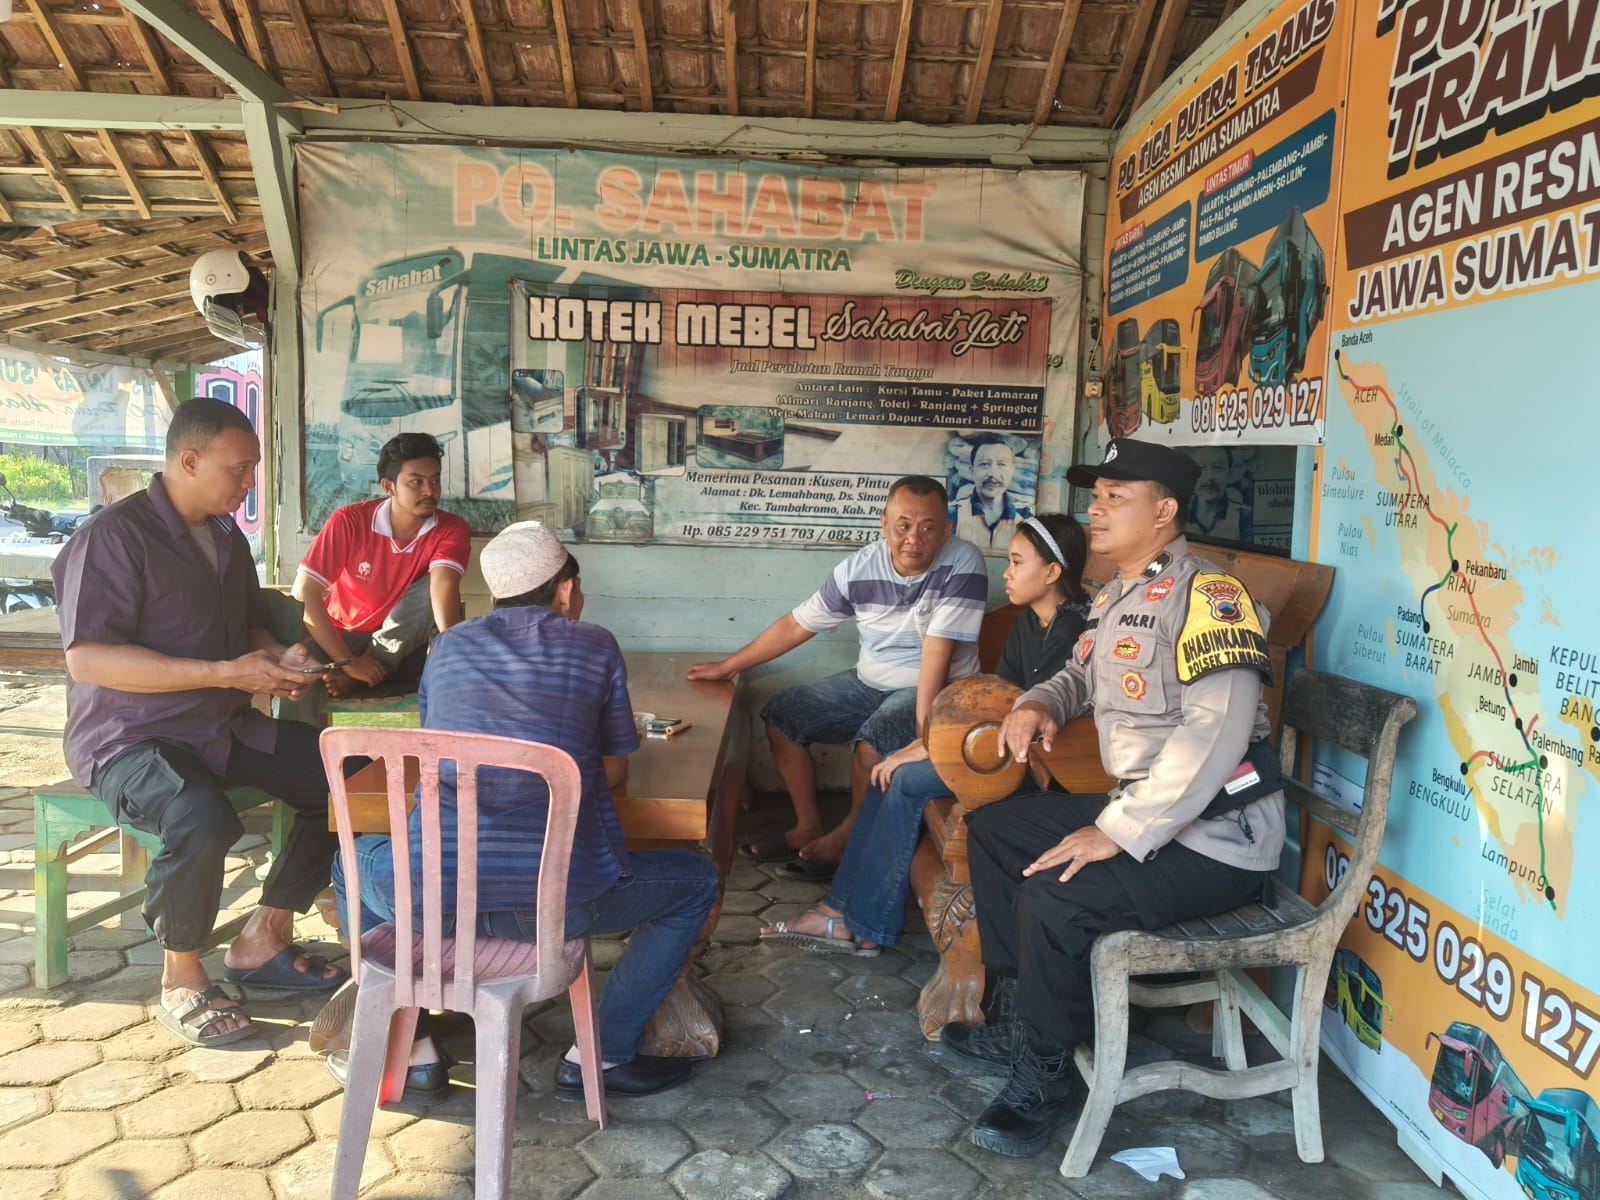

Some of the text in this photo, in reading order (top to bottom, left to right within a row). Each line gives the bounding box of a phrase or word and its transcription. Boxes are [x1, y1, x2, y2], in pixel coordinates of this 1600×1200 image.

[1388, 0, 1600, 166] TRAN
[1116, 152, 1136, 196] PO
[1174, 61, 1239, 152] PUTRA
[1244, 0, 1337, 96] TRANS
[1138, 86, 1280, 208] AGEN RESMI JAWA SUMATRA
[1206, 154, 1250, 193] LINTAS TIMUR
[453, 163, 938, 242] PO. SAHABAT
[1382, 174, 1484, 252] AGEN
[537, 237, 627, 263] LINTAS
[631, 242, 710, 267] JAWA
[727, 245, 852, 272] SUMATRA
[895, 269, 1049, 295] Dengan Sahabat
[1349, 250, 1446, 321] JAWA
[527, 295, 1028, 358] KOTEK MEBEL Sahabat Jati
[1342, 330, 1373, 347] Banda Aceh
[731, 359, 934, 381] Jual Perabotan Rumah Tangga
[795, 381, 835, 392] Antara
[838, 384, 863, 393] Lain
[878, 386, 908, 395] Kursi
[911, 387, 942, 397] Tamu
[952, 388, 984, 398] Paket
[987, 389, 1038, 400] Lamaran
[1354, 388, 1378, 403] ACEH
[879, 399, 910, 409] Tolet)
[920, 400, 967, 412] Ranjang
[982, 402, 1038, 415] Springbet
[1191, 377, 1322, 433] 081 325 029 127
[797, 410, 835, 420] Makan
[845, 411, 885, 422] Lemari
[888, 412, 922, 424] Dapur
[932, 414, 972, 425] Almari
[982, 416, 1012, 426] Bufet
[1021, 418, 1036, 427] dll
[1374, 433, 1395, 447] Medan
[1423, 418, 1433, 433] of
[1433, 433, 1472, 489] Malacca
[685, 471, 749, 484] Menerima
[752, 473, 805, 487] Pesanan
[856, 477, 890, 489] Pintu
[700, 486, 741, 497] Alamat
[749, 488, 766, 498] Dk.
[769, 489, 836, 502] Lemahbang,
[838, 492, 854, 501] Ds.
[1377, 492, 1430, 510] SUMATERA
[740, 501, 761, 511] Kec.
[765, 502, 839, 515] Tambakromo,
[842, 505, 865, 515] Kab.
[1385, 512, 1417, 529] UTARA
[682, 525, 703, 538] Hp.
[707, 526, 731, 537] 085
[735, 526, 759, 537] 229
[763, 527, 786, 538] 751
[791, 528, 814, 540] 703
[828, 530, 852, 541] 082
[855, 531, 880, 542] 313
[1340, 541, 1359, 557] Nias
[1466, 560, 1507, 580] Pekanbaru
[1447, 575, 1476, 595] RIAU
[1119, 614, 1156, 629] POLRI
[1397, 606, 1422, 628] Padang
[1353, 644, 1387, 664] Siberut
[1396, 630, 1454, 659] SUMATERA
[1188, 653, 1223, 677] POLSEK
[1405, 652, 1441, 676] BARAT
[1467, 663, 1507, 687] JAMBI
[1513, 654, 1539, 675] Jambi
[1479, 696, 1506, 721] Betung
[1532, 731, 1583, 767] Palembang
[1432, 768, 1466, 796] Bengkulu
[1487, 751, 1562, 795] SUMATERA
[1409, 781, 1471, 822] BENGKULU
[1491, 776, 1553, 815] SELATAN
[1482, 842, 1546, 891] Lampung
[1483, 888, 1516, 920] Selat
[1365, 875, 1429, 963] 325
[1434, 919, 1514, 1021] 029
[1521, 972, 1600, 1079] 127
